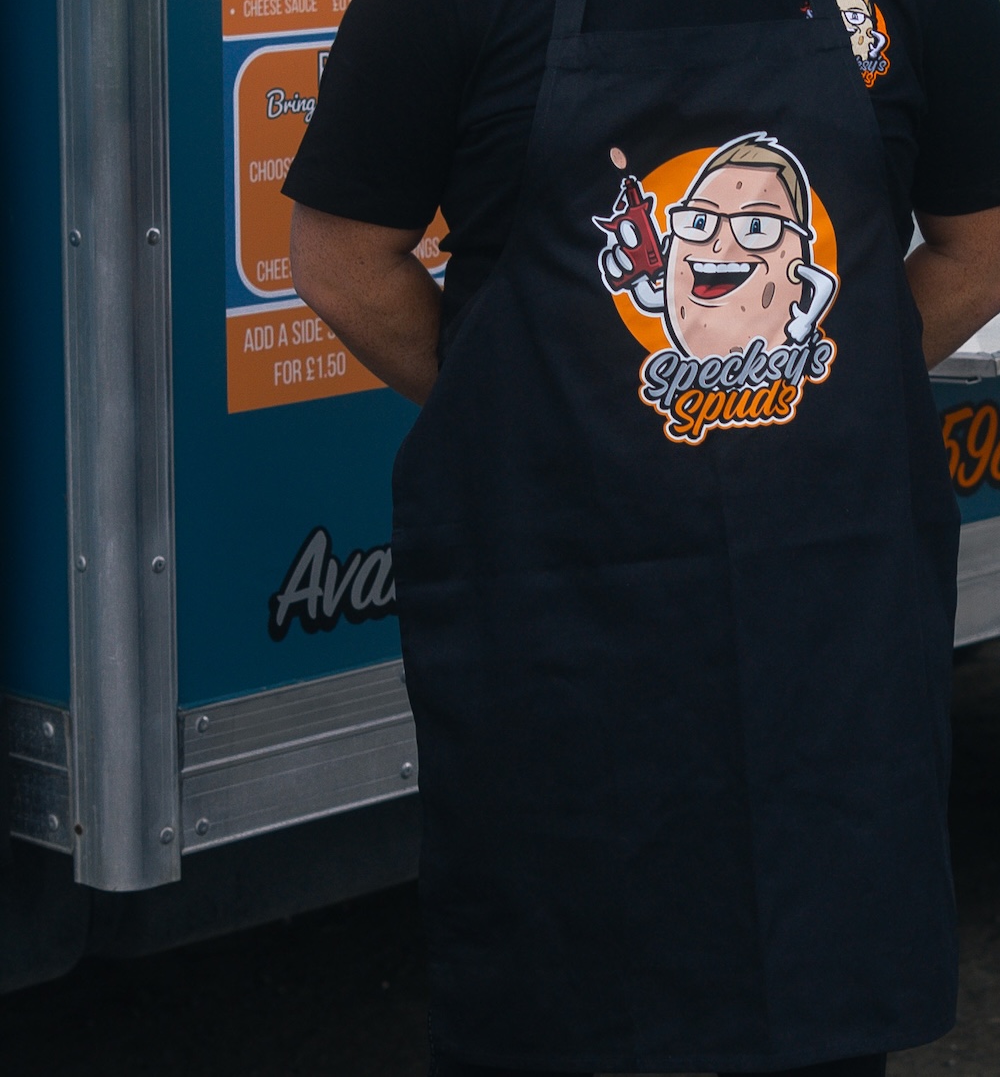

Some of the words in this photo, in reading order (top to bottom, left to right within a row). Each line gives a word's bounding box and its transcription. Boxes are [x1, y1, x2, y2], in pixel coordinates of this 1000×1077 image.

[267, 89, 315, 123] Bring
[250, 158, 293, 183] CHOOS
[257, 257, 292, 282] CHEE
[244, 325, 274, 352] ADD
[278, 324, 288, 347] A
[292, 318, 322, 345] SIDE
[274, 359, 302, 386] FOR
[306, 352, 346, 381] £1.50
[648, 334, 830, 405] Specksy's
[276, 530, 396, 626] Ava
